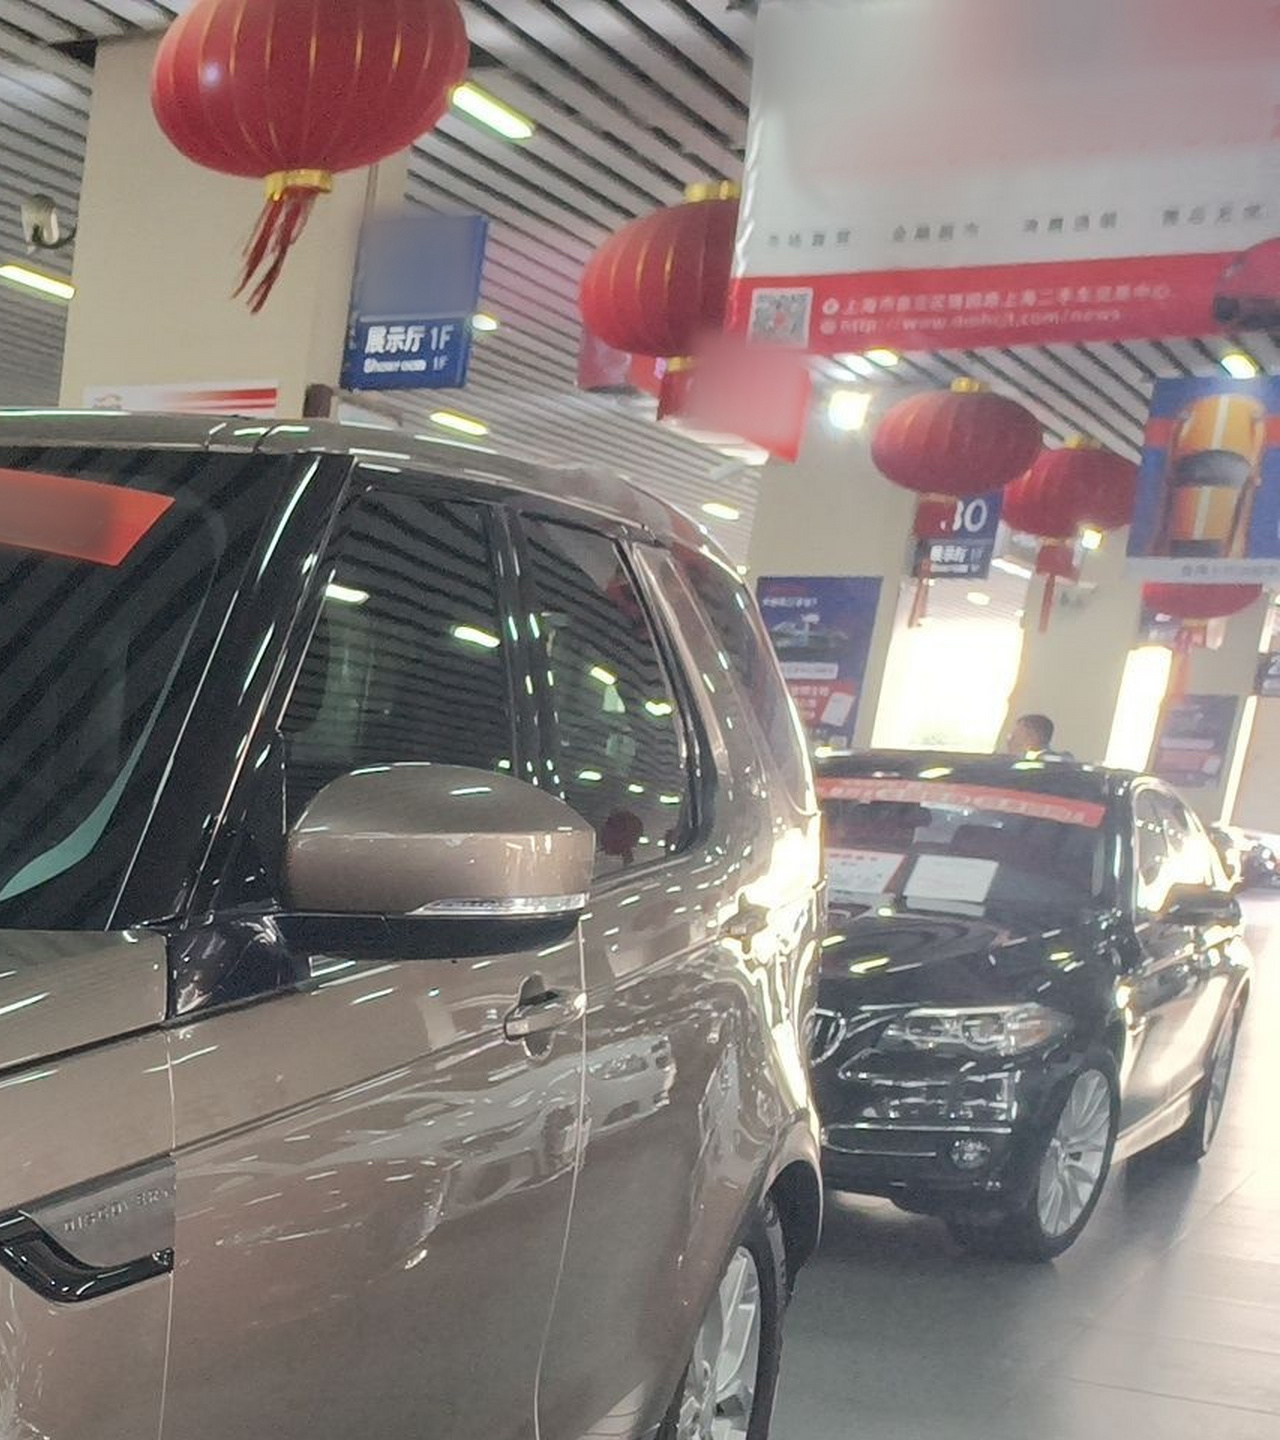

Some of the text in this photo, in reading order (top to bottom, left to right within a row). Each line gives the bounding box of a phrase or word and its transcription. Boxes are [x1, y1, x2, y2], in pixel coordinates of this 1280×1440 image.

[365, 324, 454, 354] 展示厅 1F
